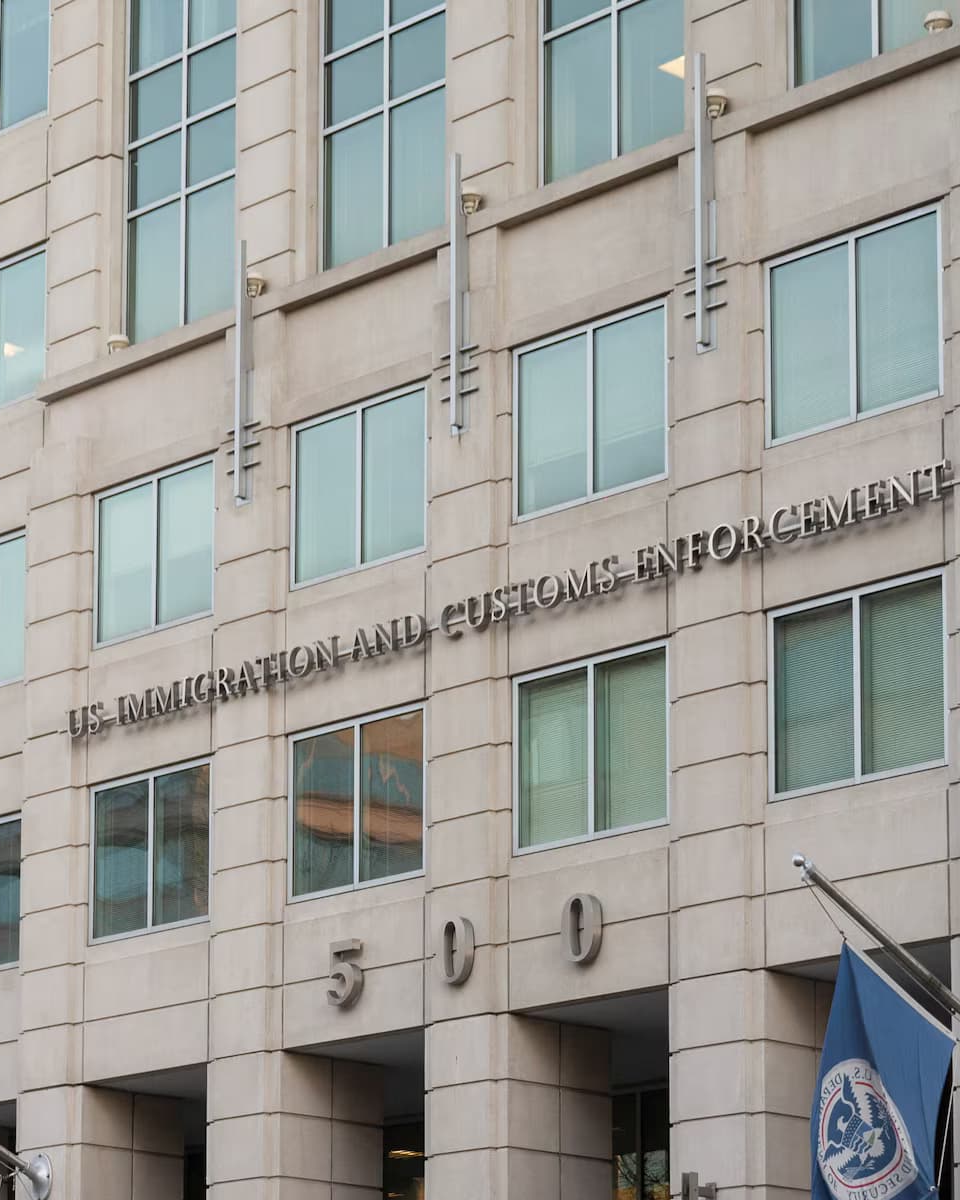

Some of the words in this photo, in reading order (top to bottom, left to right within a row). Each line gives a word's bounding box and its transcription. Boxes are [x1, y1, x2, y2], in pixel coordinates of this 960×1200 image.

[66, 702, 104, 737] US
[116, 636, 340, 725] IMMIGRATION
[350, 613, 426, 662] AND
[441, 555, 618, 638] CUSTOMS
[632, 459, 951, 583] ENFORCEMENT
